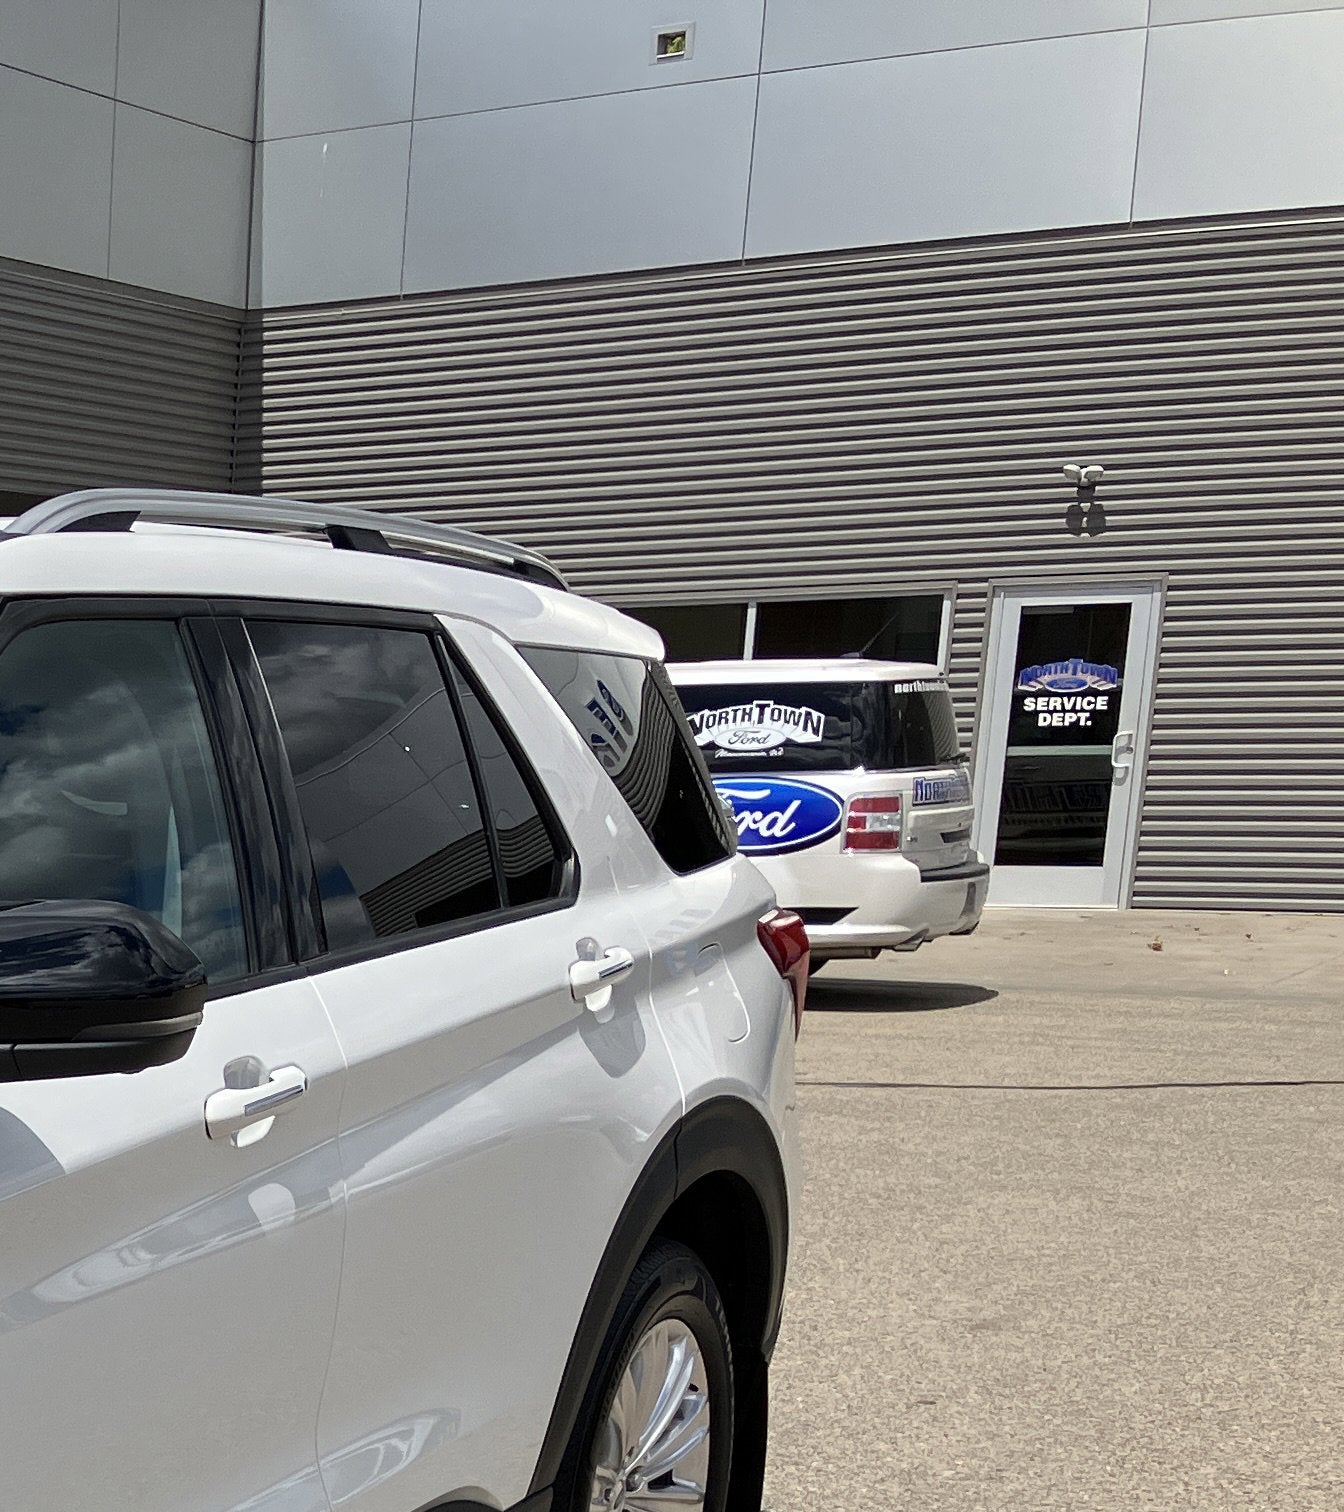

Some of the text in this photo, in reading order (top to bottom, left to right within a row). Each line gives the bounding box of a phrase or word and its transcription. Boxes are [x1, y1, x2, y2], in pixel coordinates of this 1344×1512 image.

[1023, 696, 1109, 711] SERVICE
[1037, 712, 1093, 727] DEPT.
[728, 730, 772, 746] Ford
